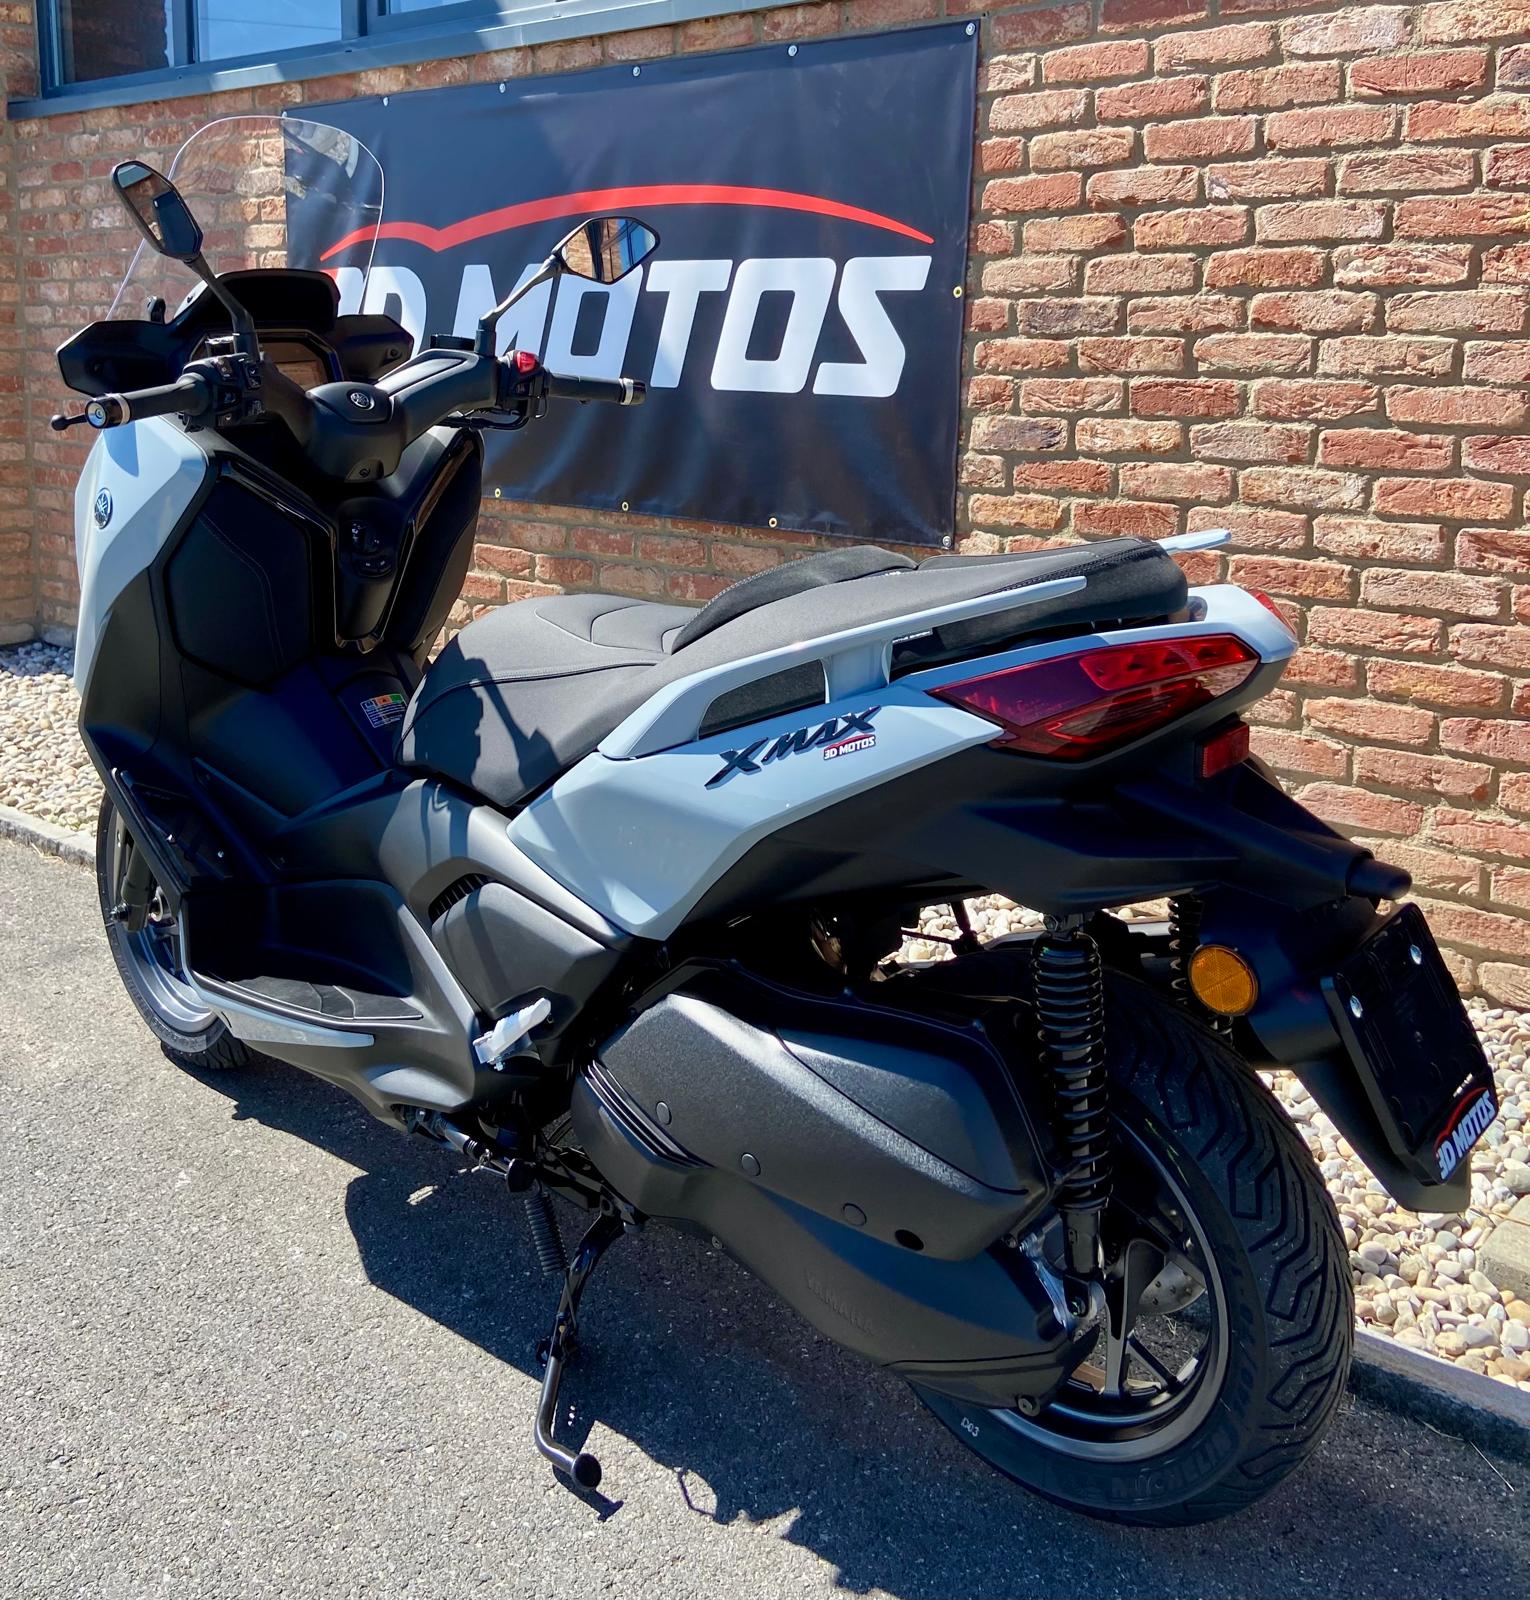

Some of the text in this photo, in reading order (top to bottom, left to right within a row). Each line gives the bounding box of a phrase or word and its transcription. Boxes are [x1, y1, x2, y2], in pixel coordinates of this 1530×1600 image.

[452, 255, 932, 398] MOTOS
[824, 736, 876, 760] 3D MOTOS
[1436, 1140, 1457, 1180] 3D
[1452, 1089, 1496, 1158] MOTOS
